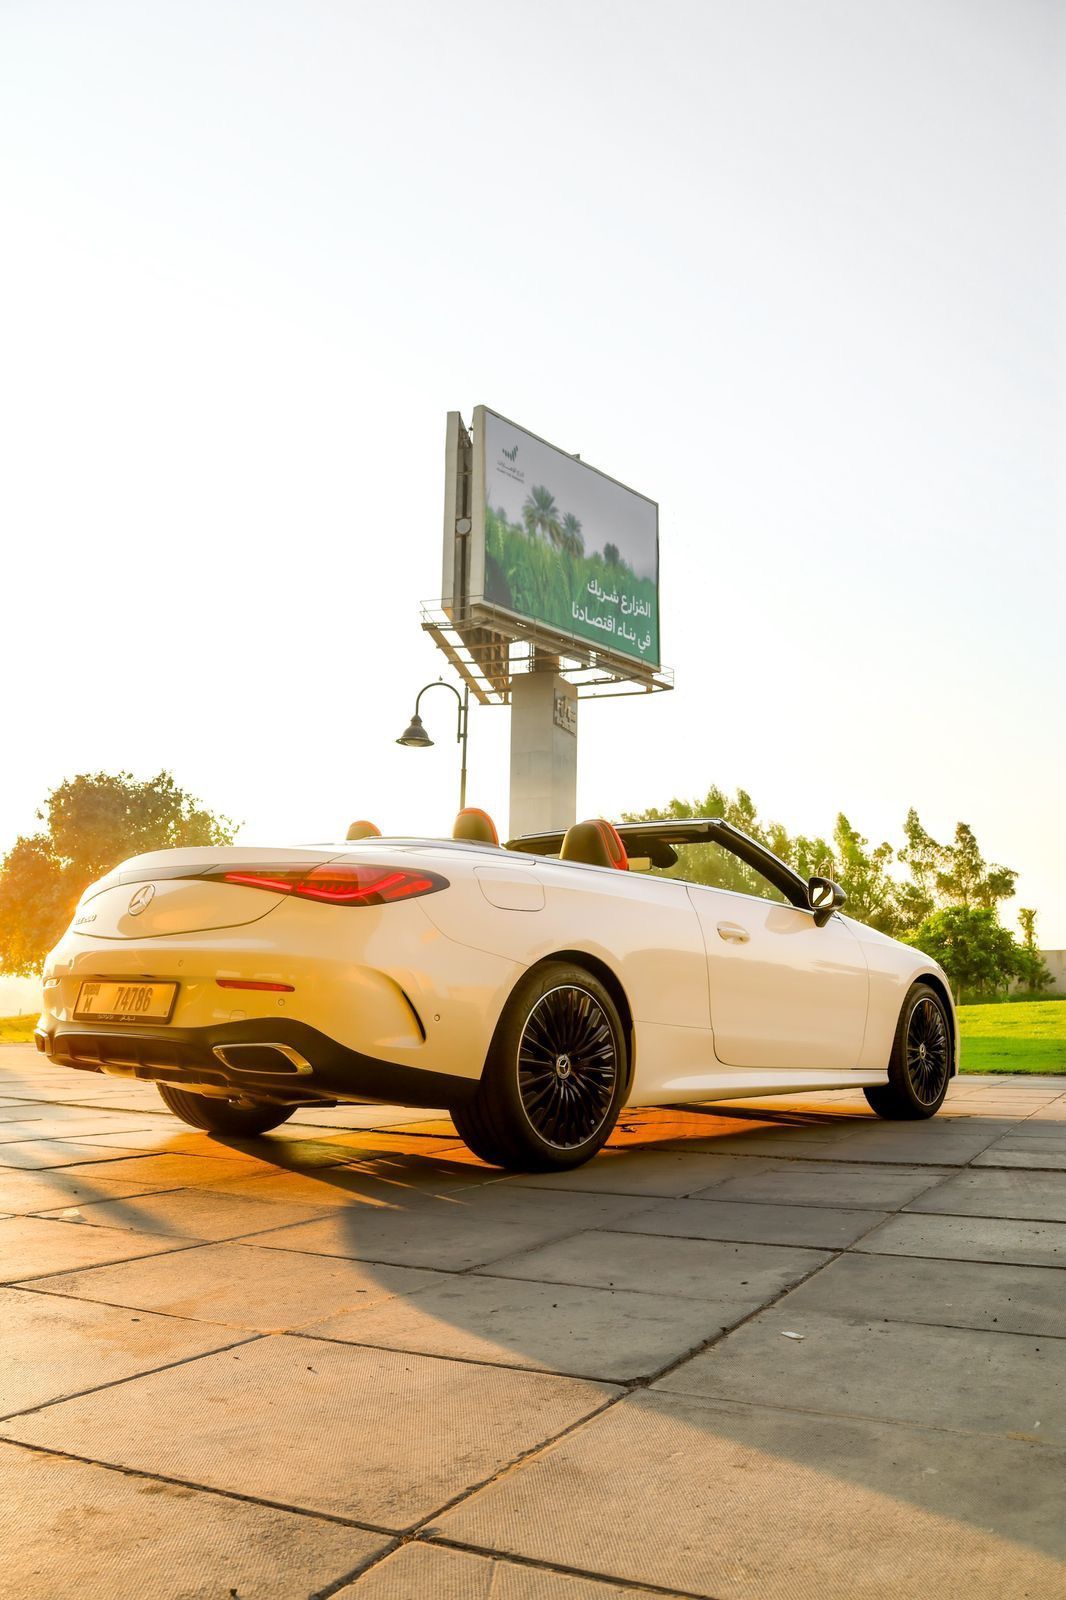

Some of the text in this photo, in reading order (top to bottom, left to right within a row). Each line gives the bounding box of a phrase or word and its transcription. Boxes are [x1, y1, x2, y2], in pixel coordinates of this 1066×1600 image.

[587, 579, 619, 604] شريك
[572, 601, 651, 654] في بناء اقتصادنا
[113, 987, 153, 1012] 74786
